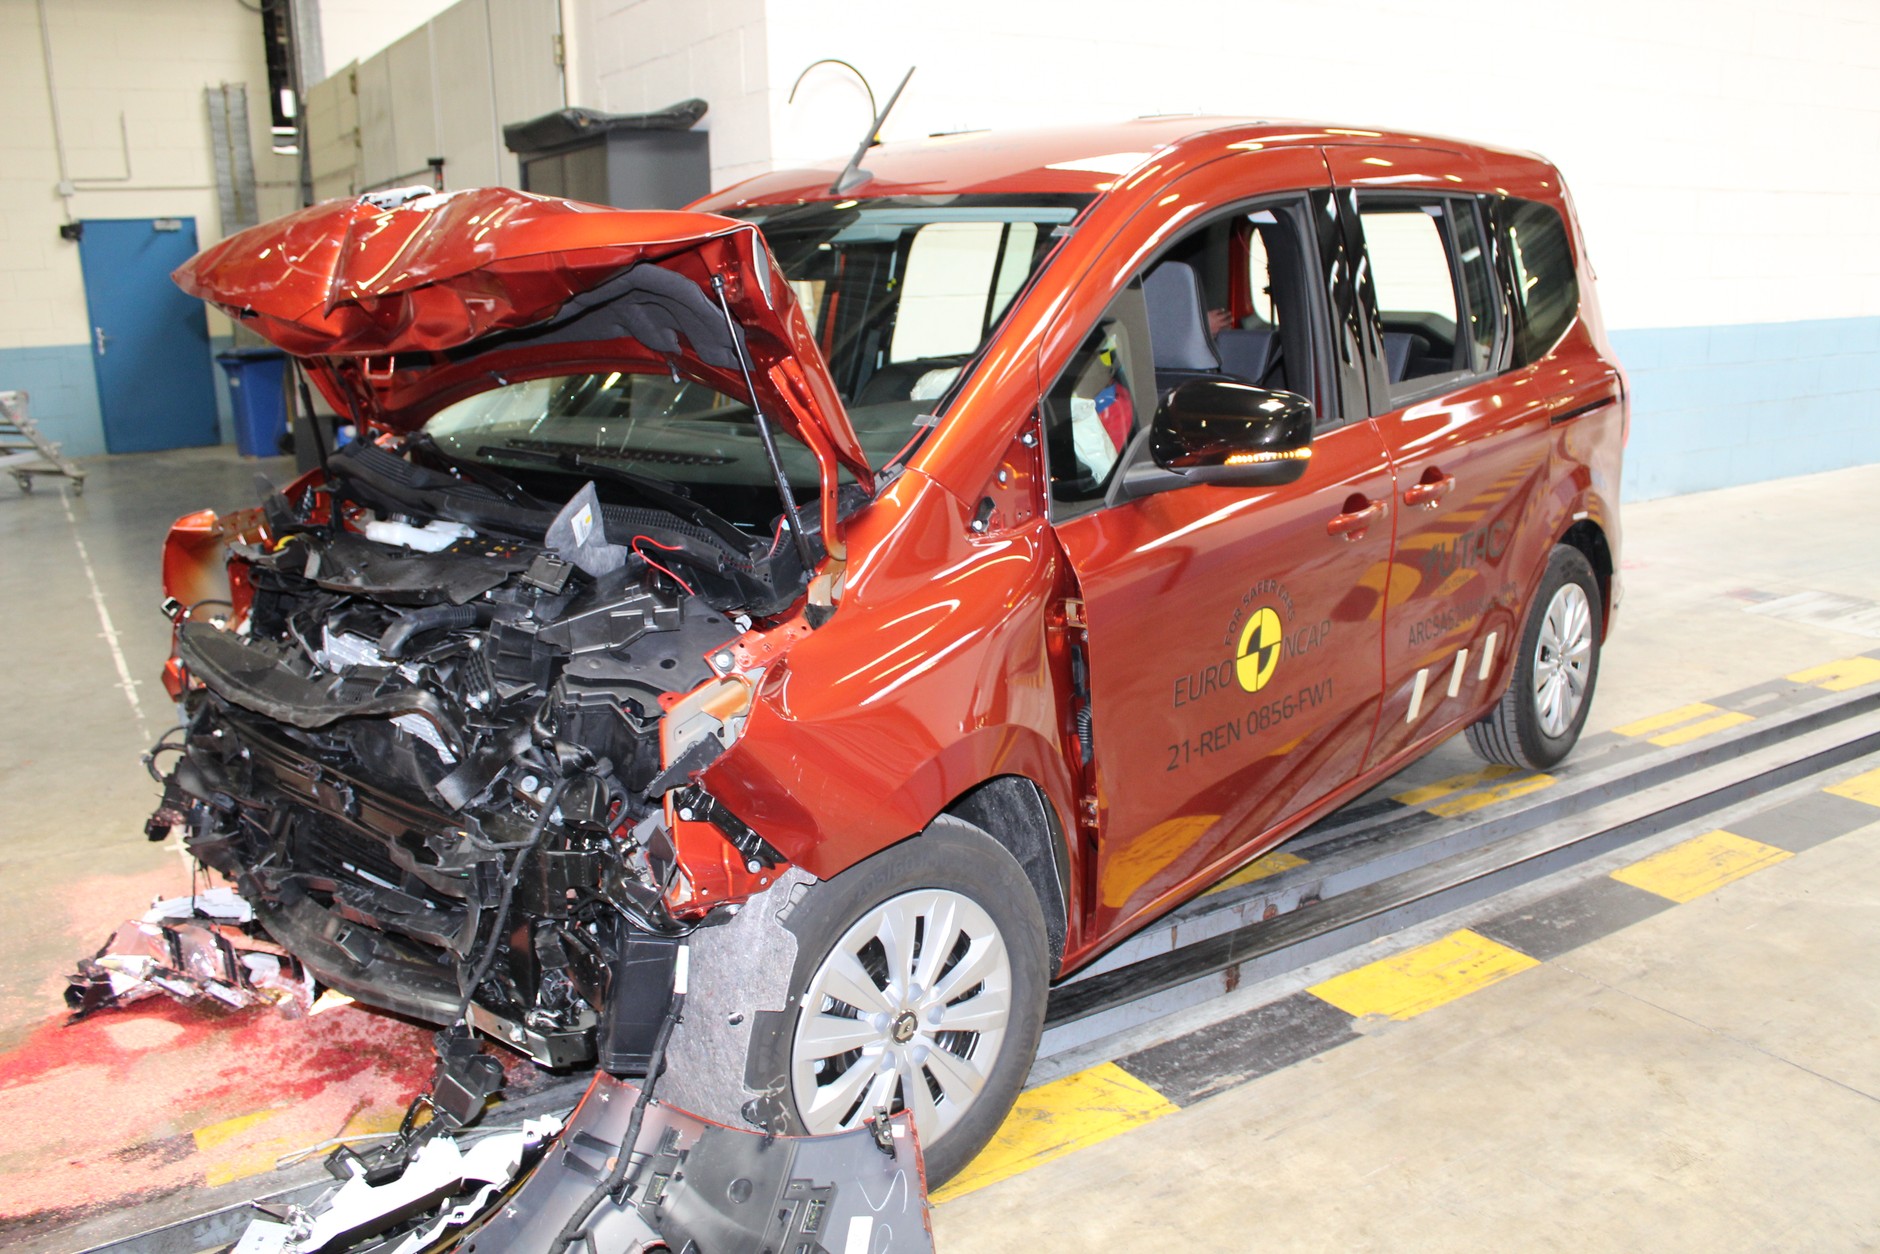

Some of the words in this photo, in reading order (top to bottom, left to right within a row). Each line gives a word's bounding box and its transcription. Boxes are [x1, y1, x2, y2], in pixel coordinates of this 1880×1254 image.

[1225, 607, 1242, 646] FOR
[1242, 579, 1277, 608] SAFER
[1277, 584, 1295, 621] CARS
[1173, 659, 1233, 709] EURO
[1282, 619, 1331, 662] NCAP
[1166, 718, 1242, 772] 21-REN
[1247, 677, 1334, 735] 0856-FW1
